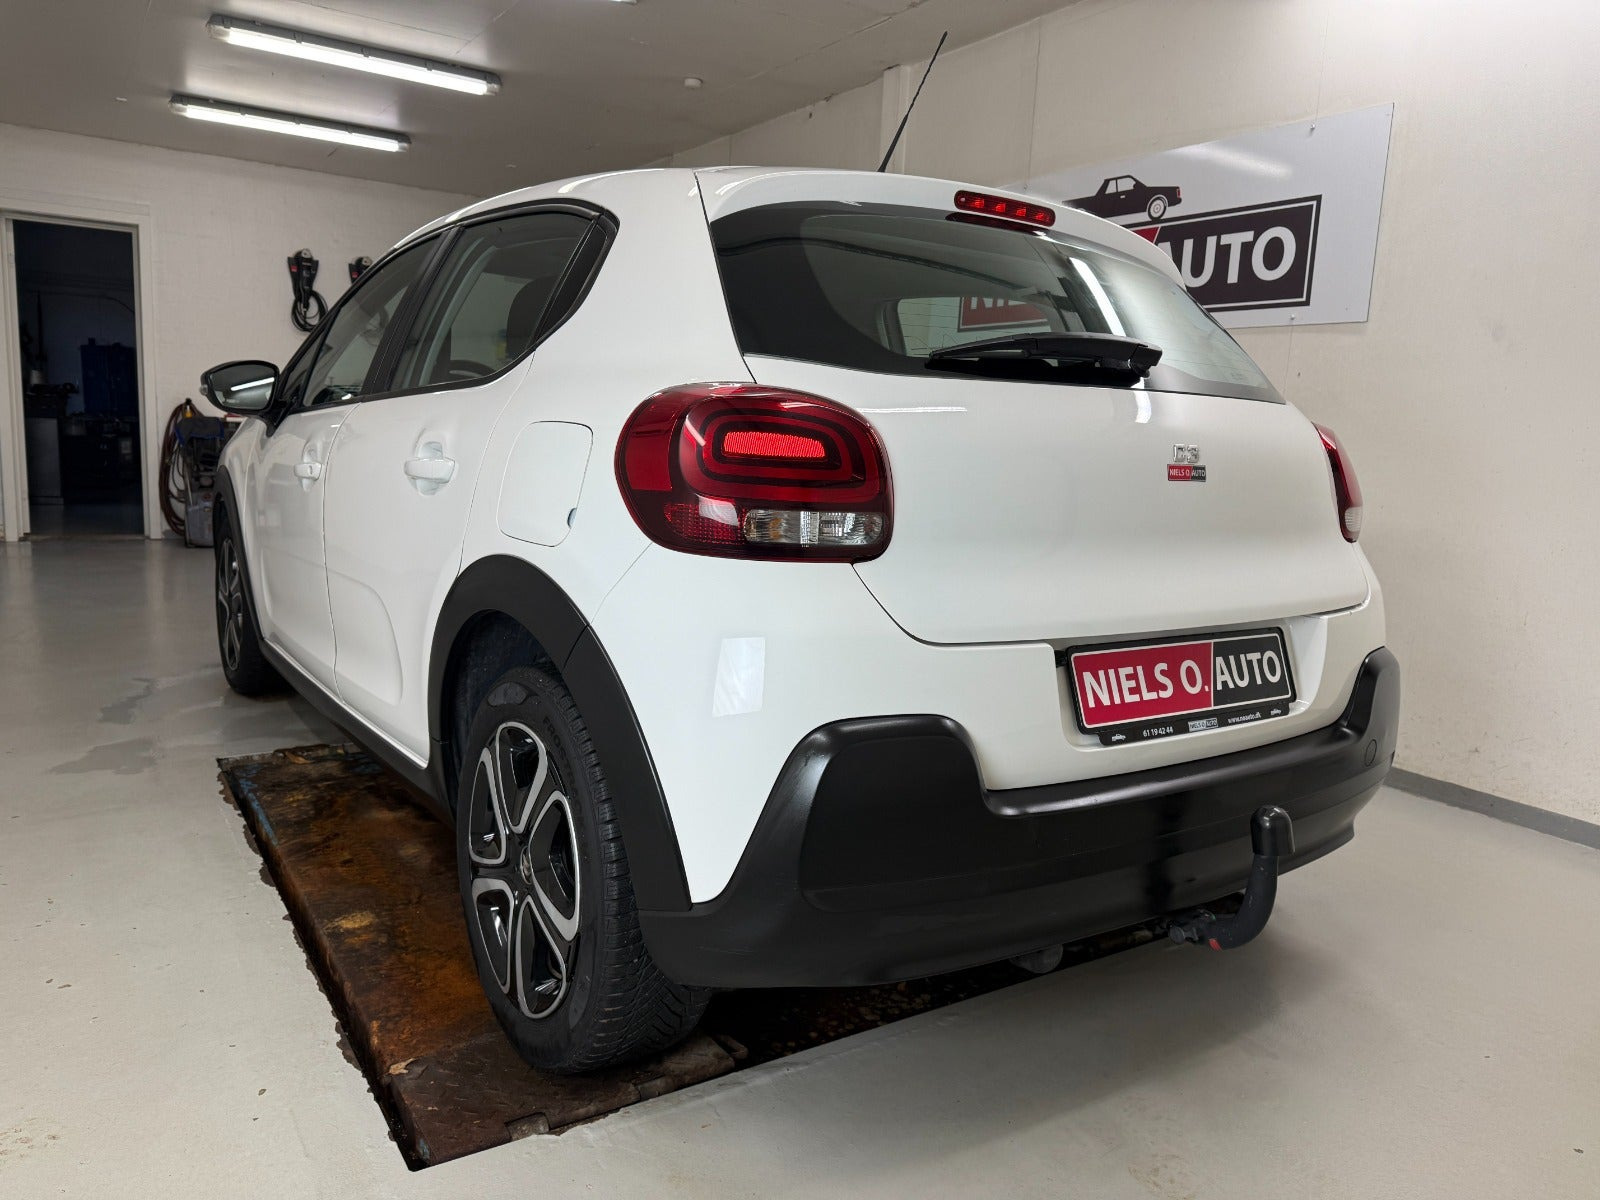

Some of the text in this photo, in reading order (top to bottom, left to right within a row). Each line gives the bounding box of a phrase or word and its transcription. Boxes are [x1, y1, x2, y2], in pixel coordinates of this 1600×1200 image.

[1082, 650, 1282, 708] NIELS O. AUTO
